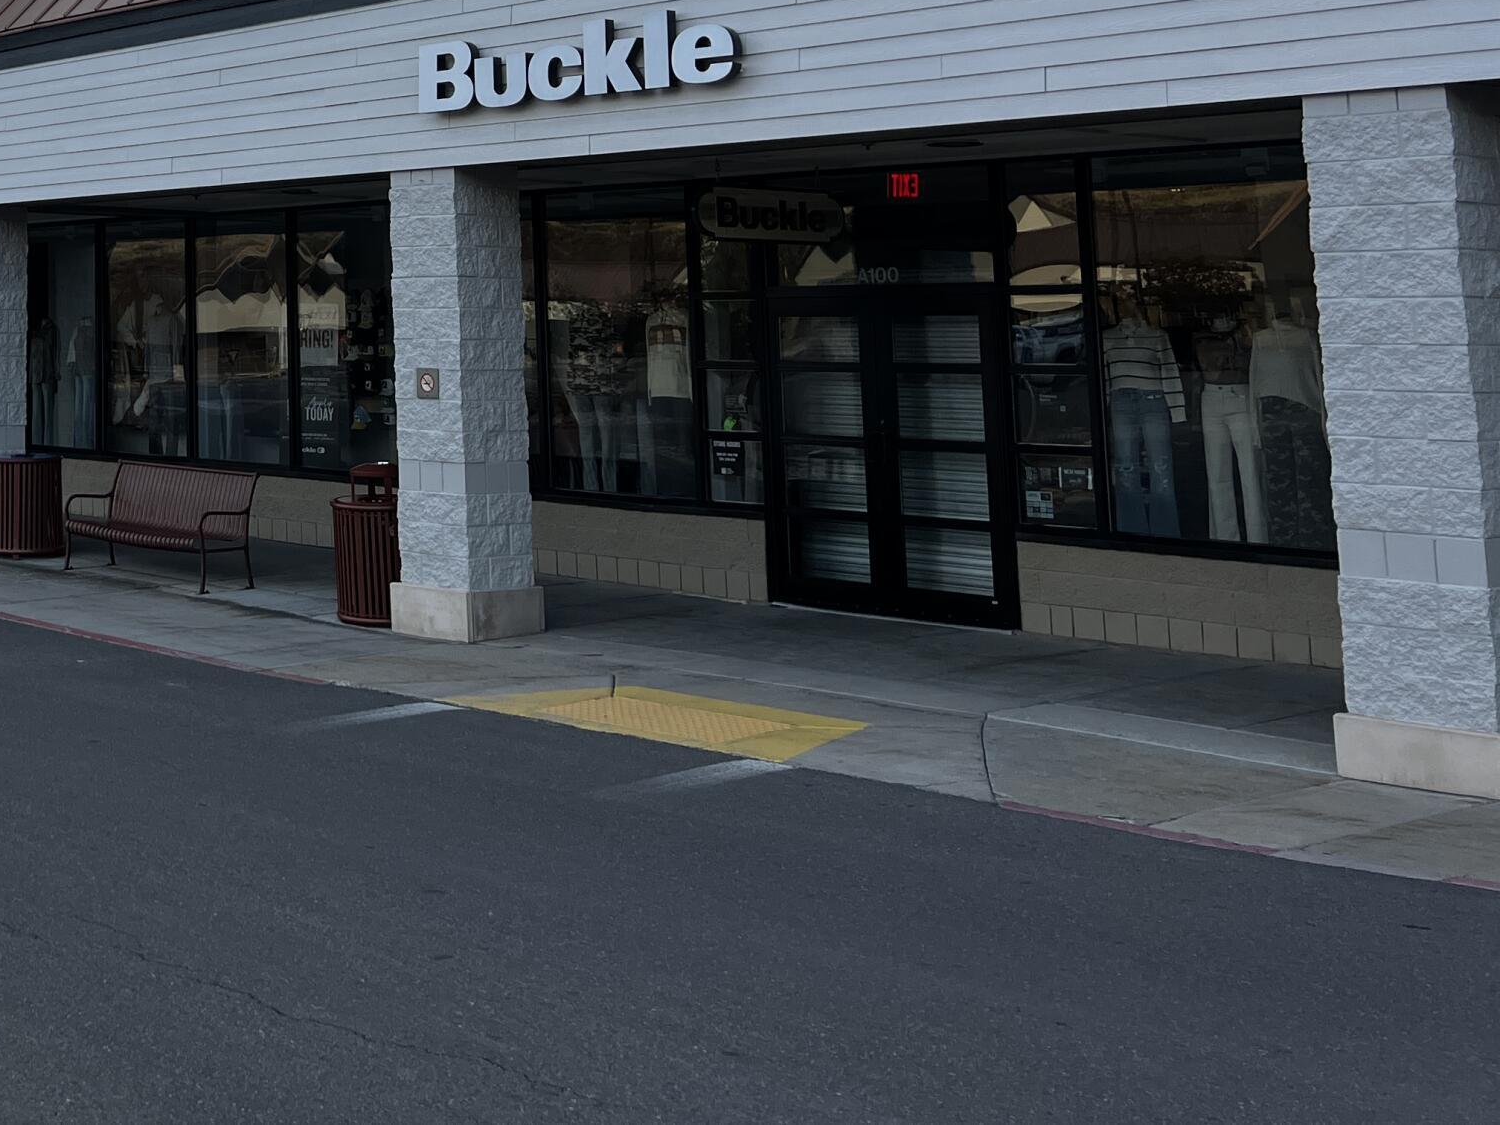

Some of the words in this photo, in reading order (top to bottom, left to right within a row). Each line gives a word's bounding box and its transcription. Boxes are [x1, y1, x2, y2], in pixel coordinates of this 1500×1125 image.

[418, 9, 742, 114] Buckle
[715, 196, 828, 233] Buckle
[858, 266, 900, 284] A100
[300, 329, 334, 348] RING!
[305, 406, 334, 422] TODAY
